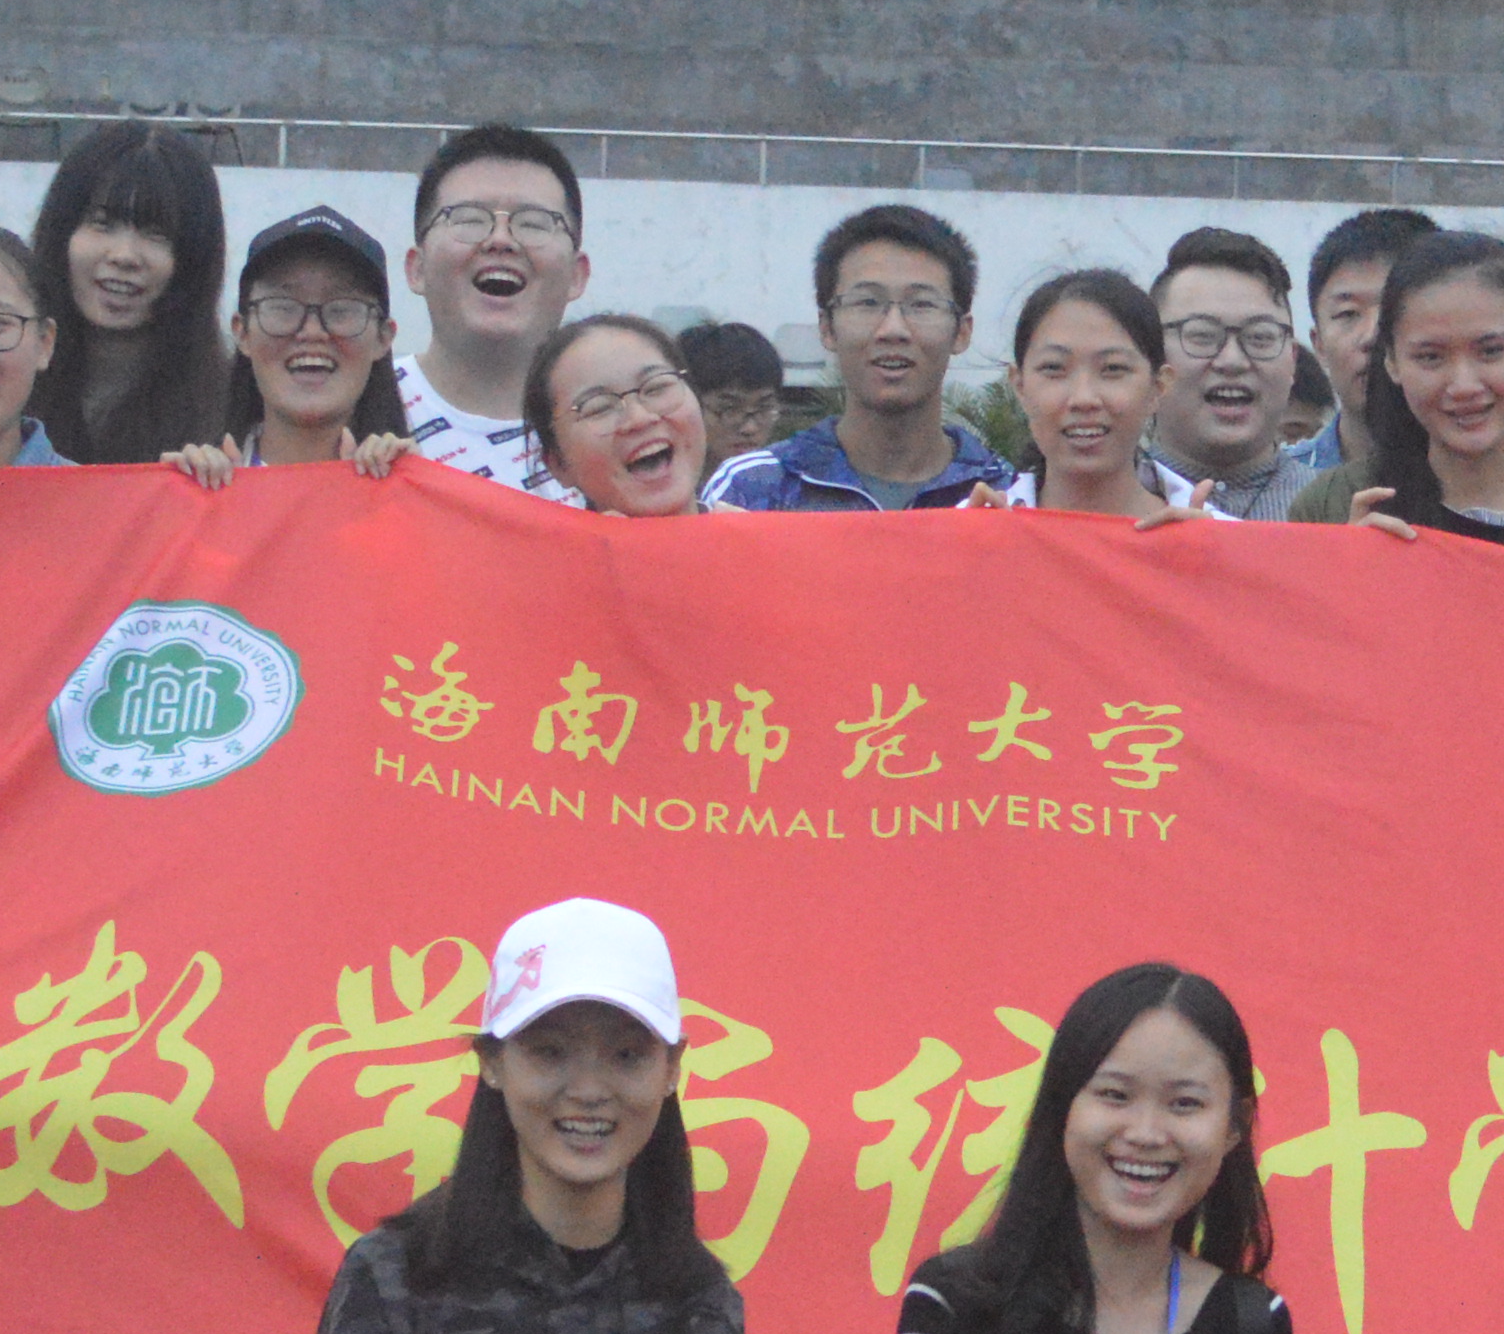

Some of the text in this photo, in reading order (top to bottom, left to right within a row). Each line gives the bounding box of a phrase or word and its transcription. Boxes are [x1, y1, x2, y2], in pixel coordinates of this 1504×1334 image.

[119, 619, 209, 640] NORMAL
[218, 629, 281, 705] UNIVERSITY
[381, 642, 1184, 793] 海南师范大学
[374, 747, 1179, 842] HAINAN NORMAL UNIVERSITY
